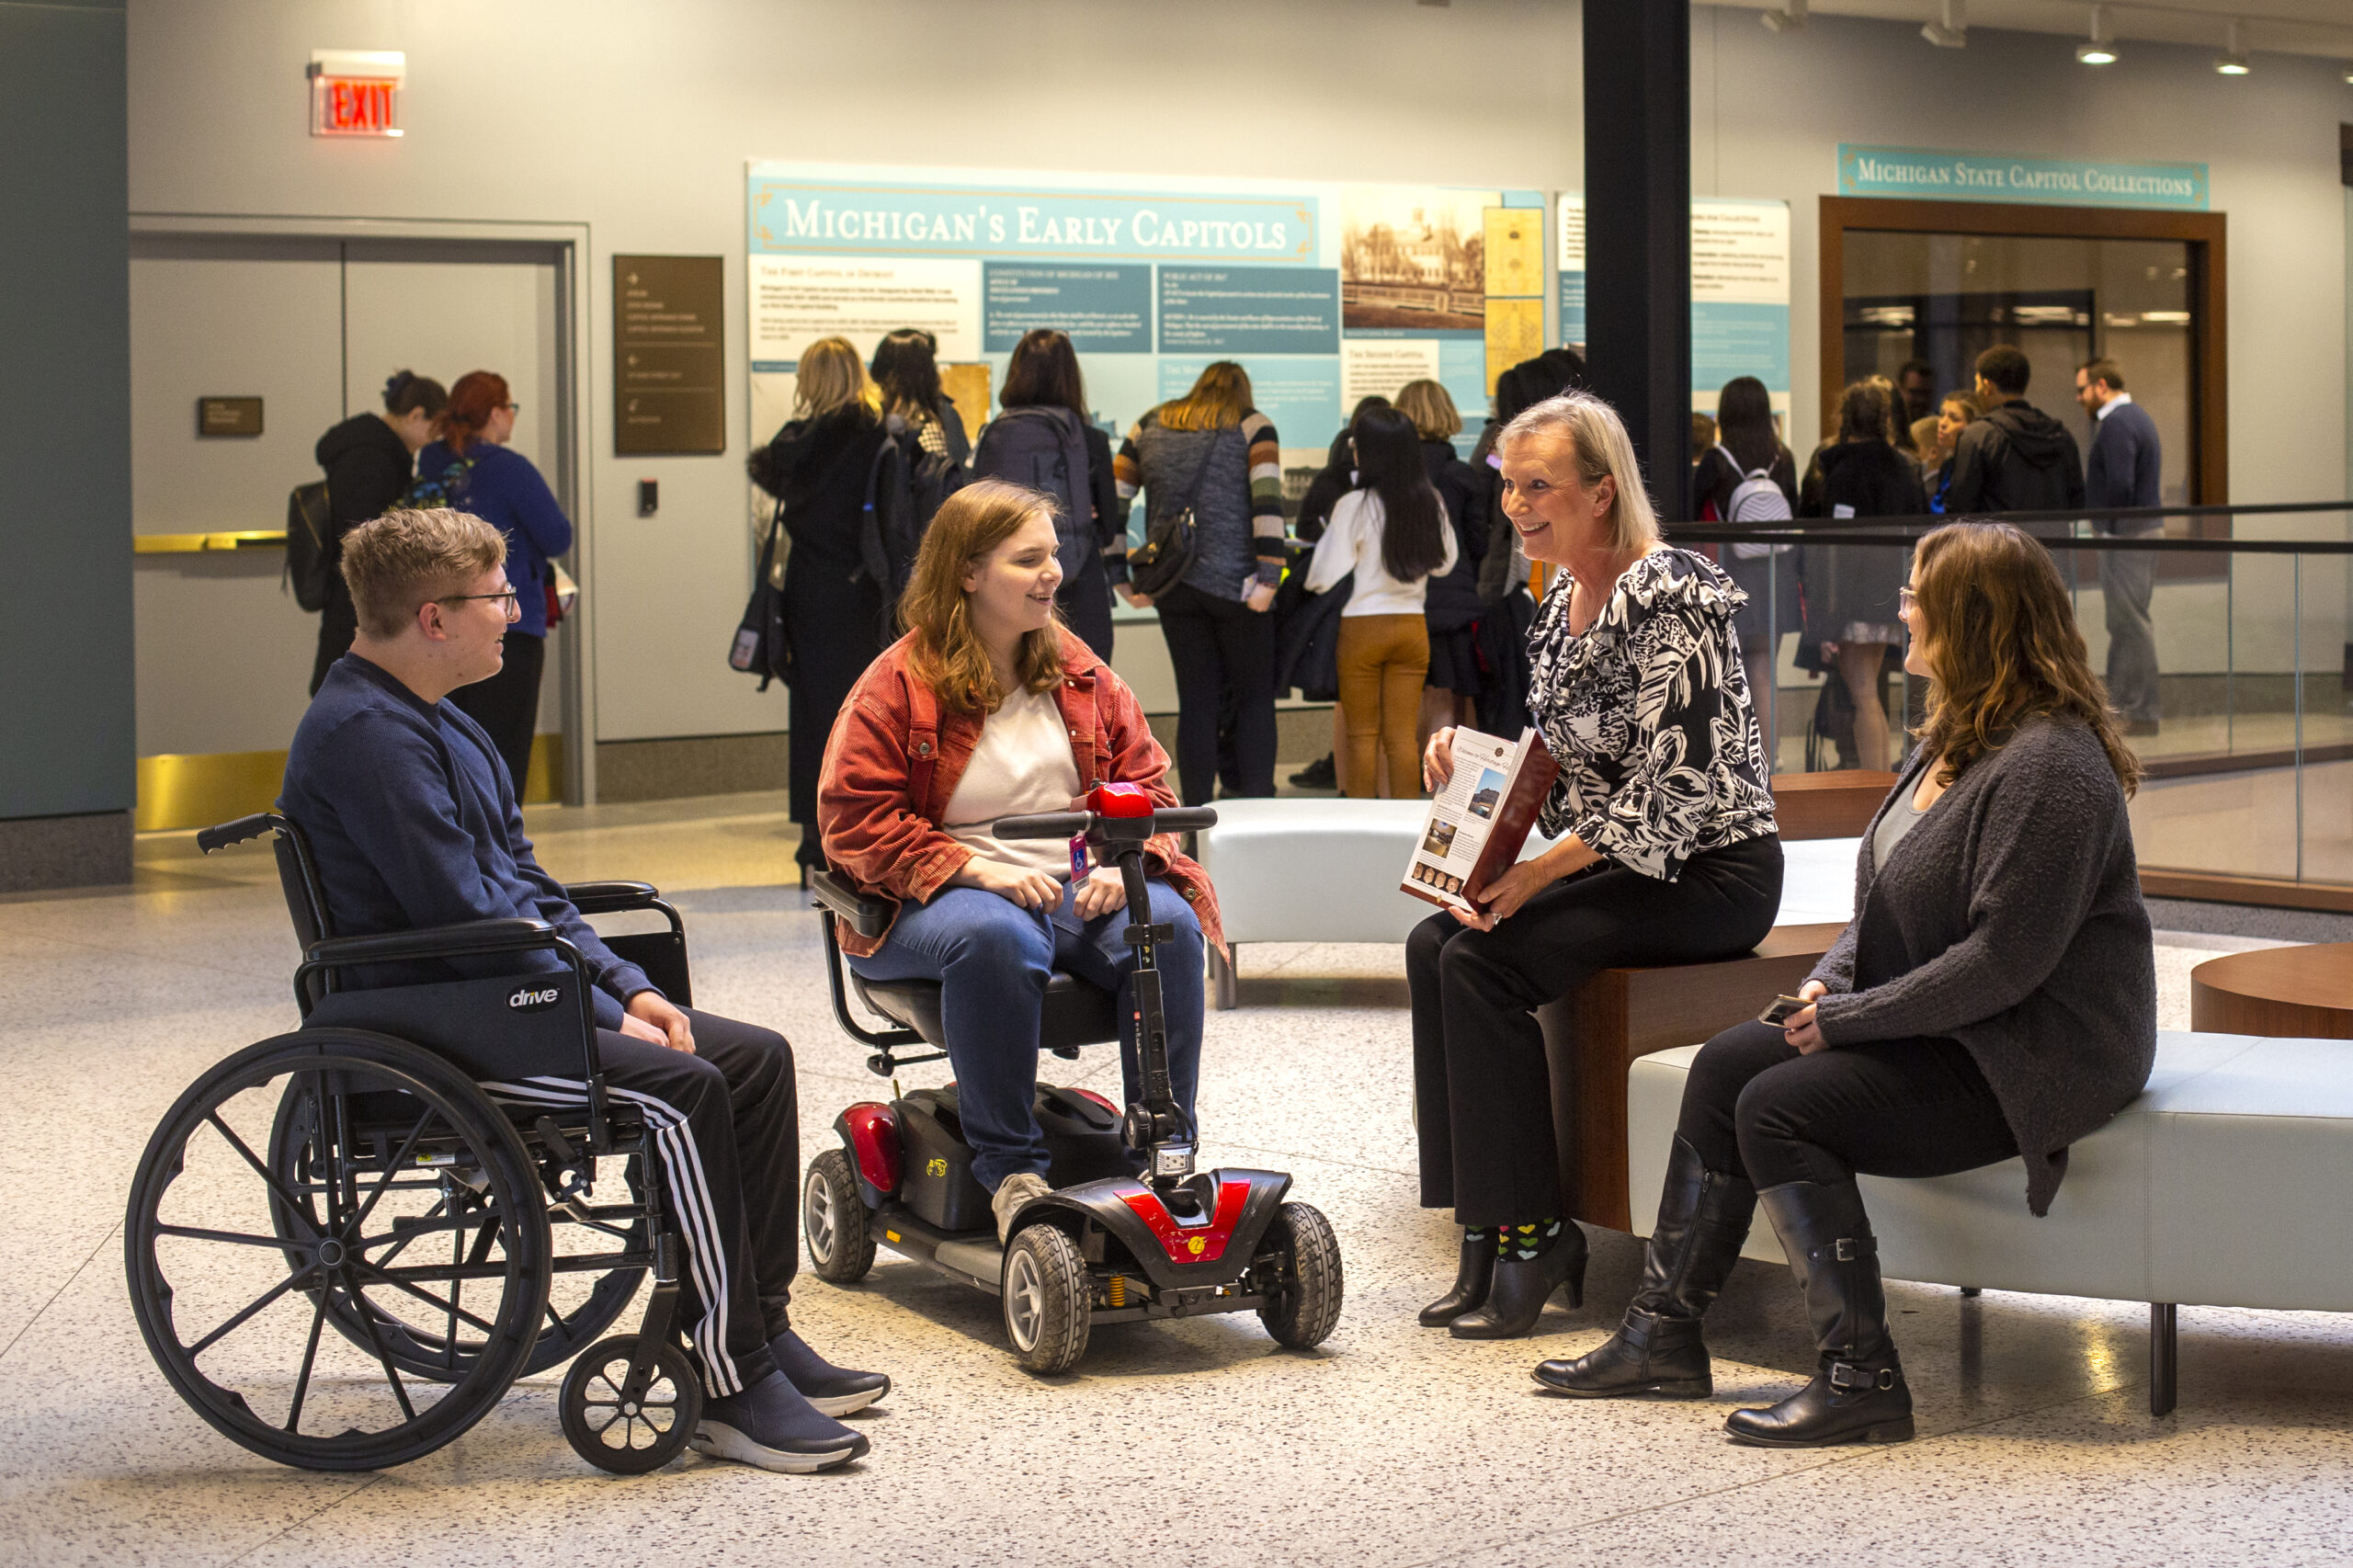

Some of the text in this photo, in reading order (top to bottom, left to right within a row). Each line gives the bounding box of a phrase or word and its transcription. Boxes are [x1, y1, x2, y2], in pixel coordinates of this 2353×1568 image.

[333, 83, 394, 128] EXIT
[1858, 157, 2193, 198] MICHIGAN STATE CAPITOL COLLECTIONS
[785, 199, 1288, 251] MICHIGAN'S EARLY CAPITOLS
[509, 989, 558, 1007] drive
